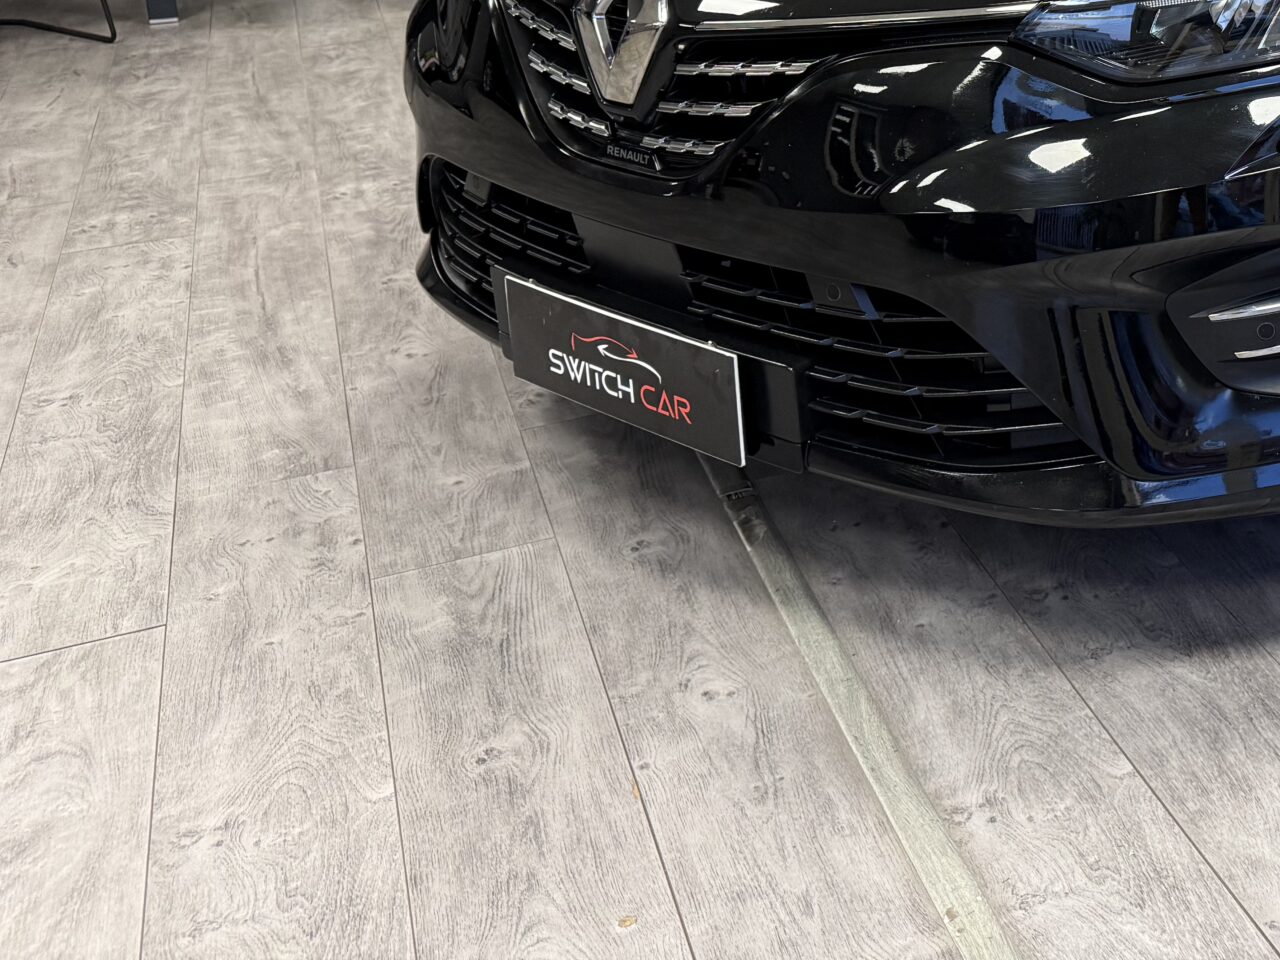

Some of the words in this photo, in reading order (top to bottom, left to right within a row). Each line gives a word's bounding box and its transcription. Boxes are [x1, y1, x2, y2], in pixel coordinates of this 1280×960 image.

[606, 145, 650, 165] RENAULT
[548, 348, 635, 404] SWITCH
[639, 384, 693, 425] CAR
